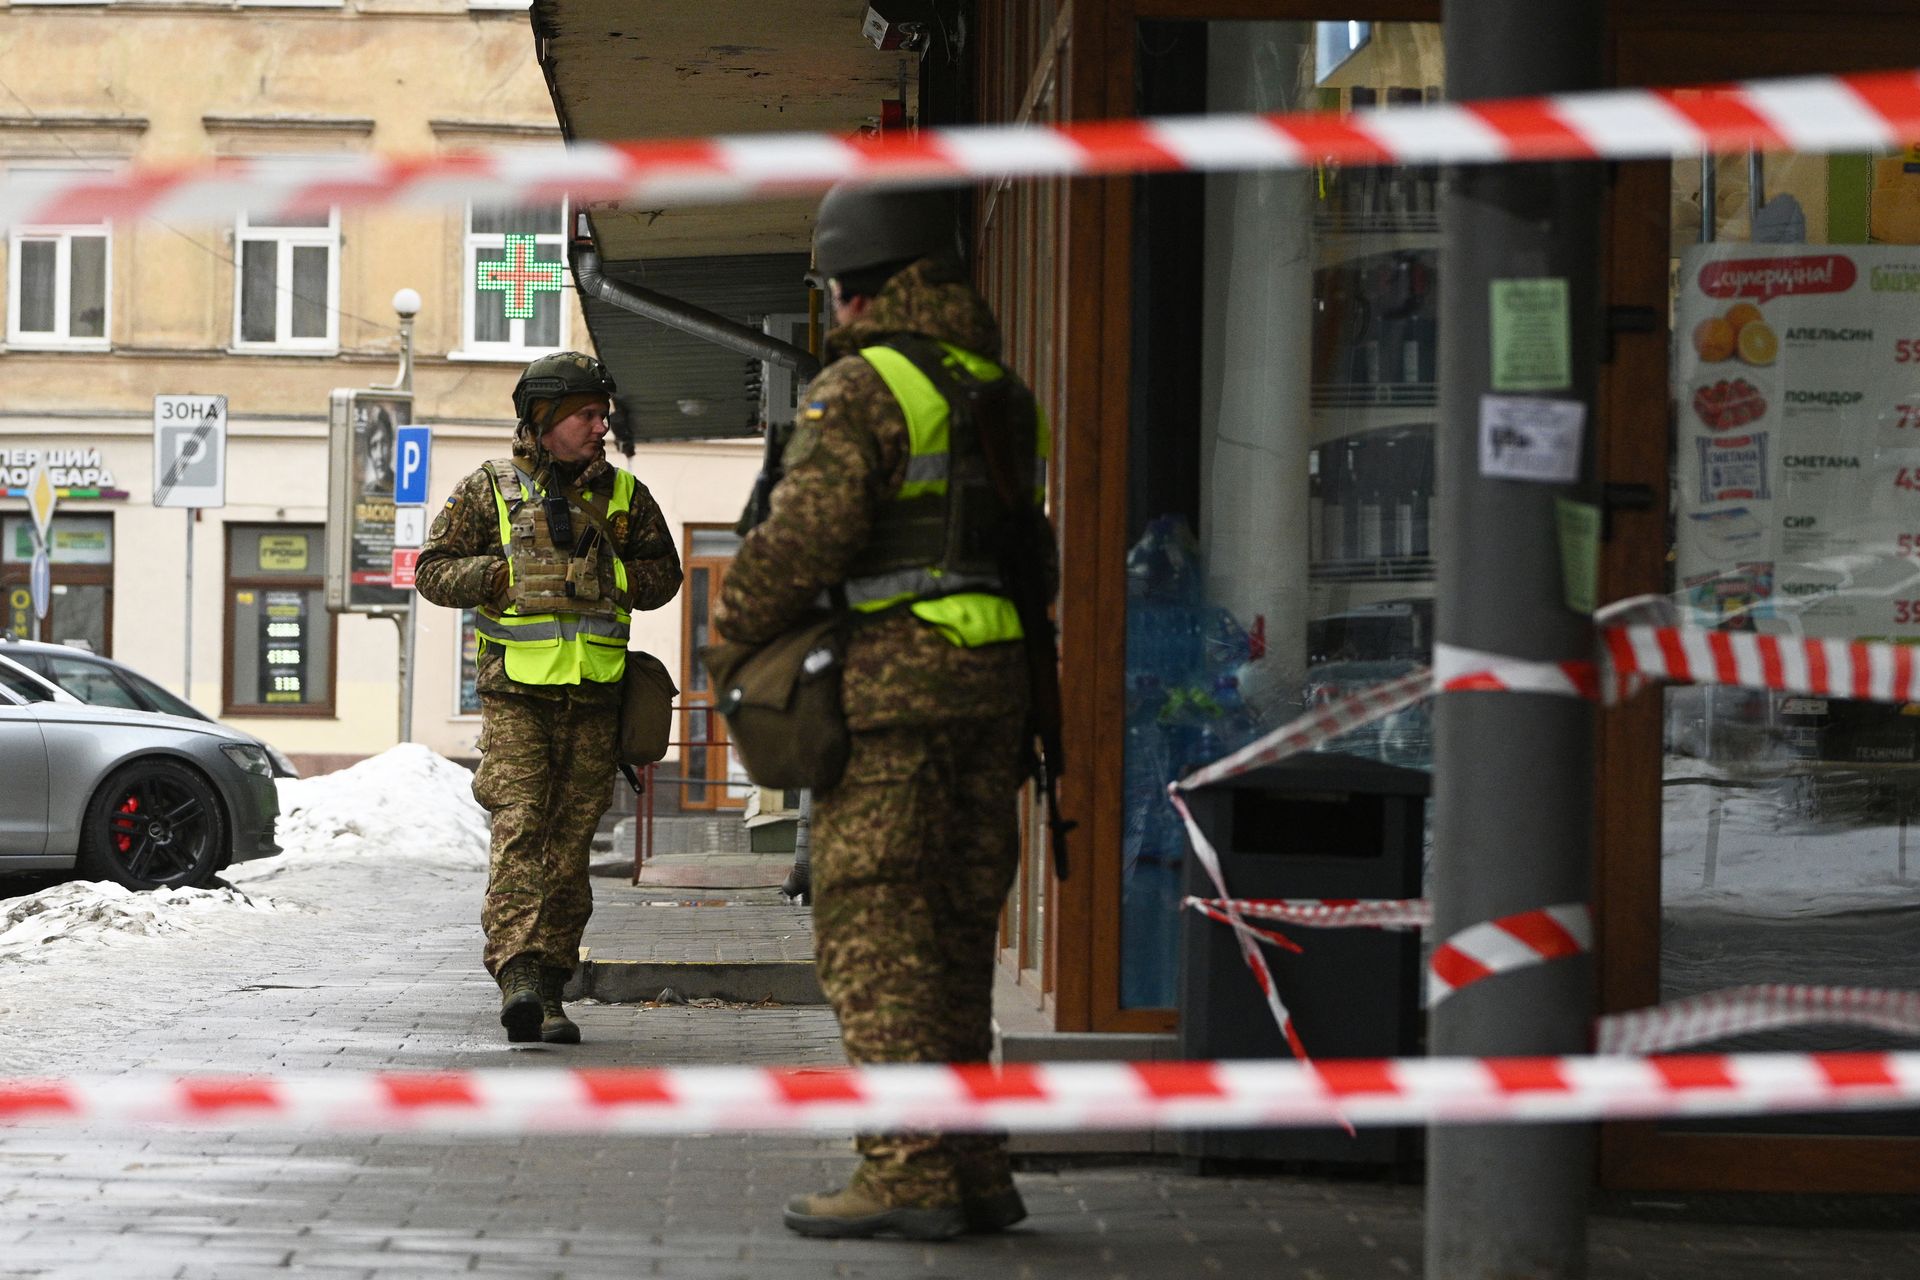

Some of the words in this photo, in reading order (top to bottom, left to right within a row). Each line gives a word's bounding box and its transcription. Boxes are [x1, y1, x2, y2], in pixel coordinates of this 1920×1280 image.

[1786, 328, 1874, 340] АПЕЛЬСИН
[1784, 391, 1863, 405] ПОМІДОР
[162, 402, 219, 420] ЗОНА
[403, 440, 421, 490] P
[1782, 455, 1860, 468] СМЕТАНА
[1782, 516, 1816, 528] СИР
